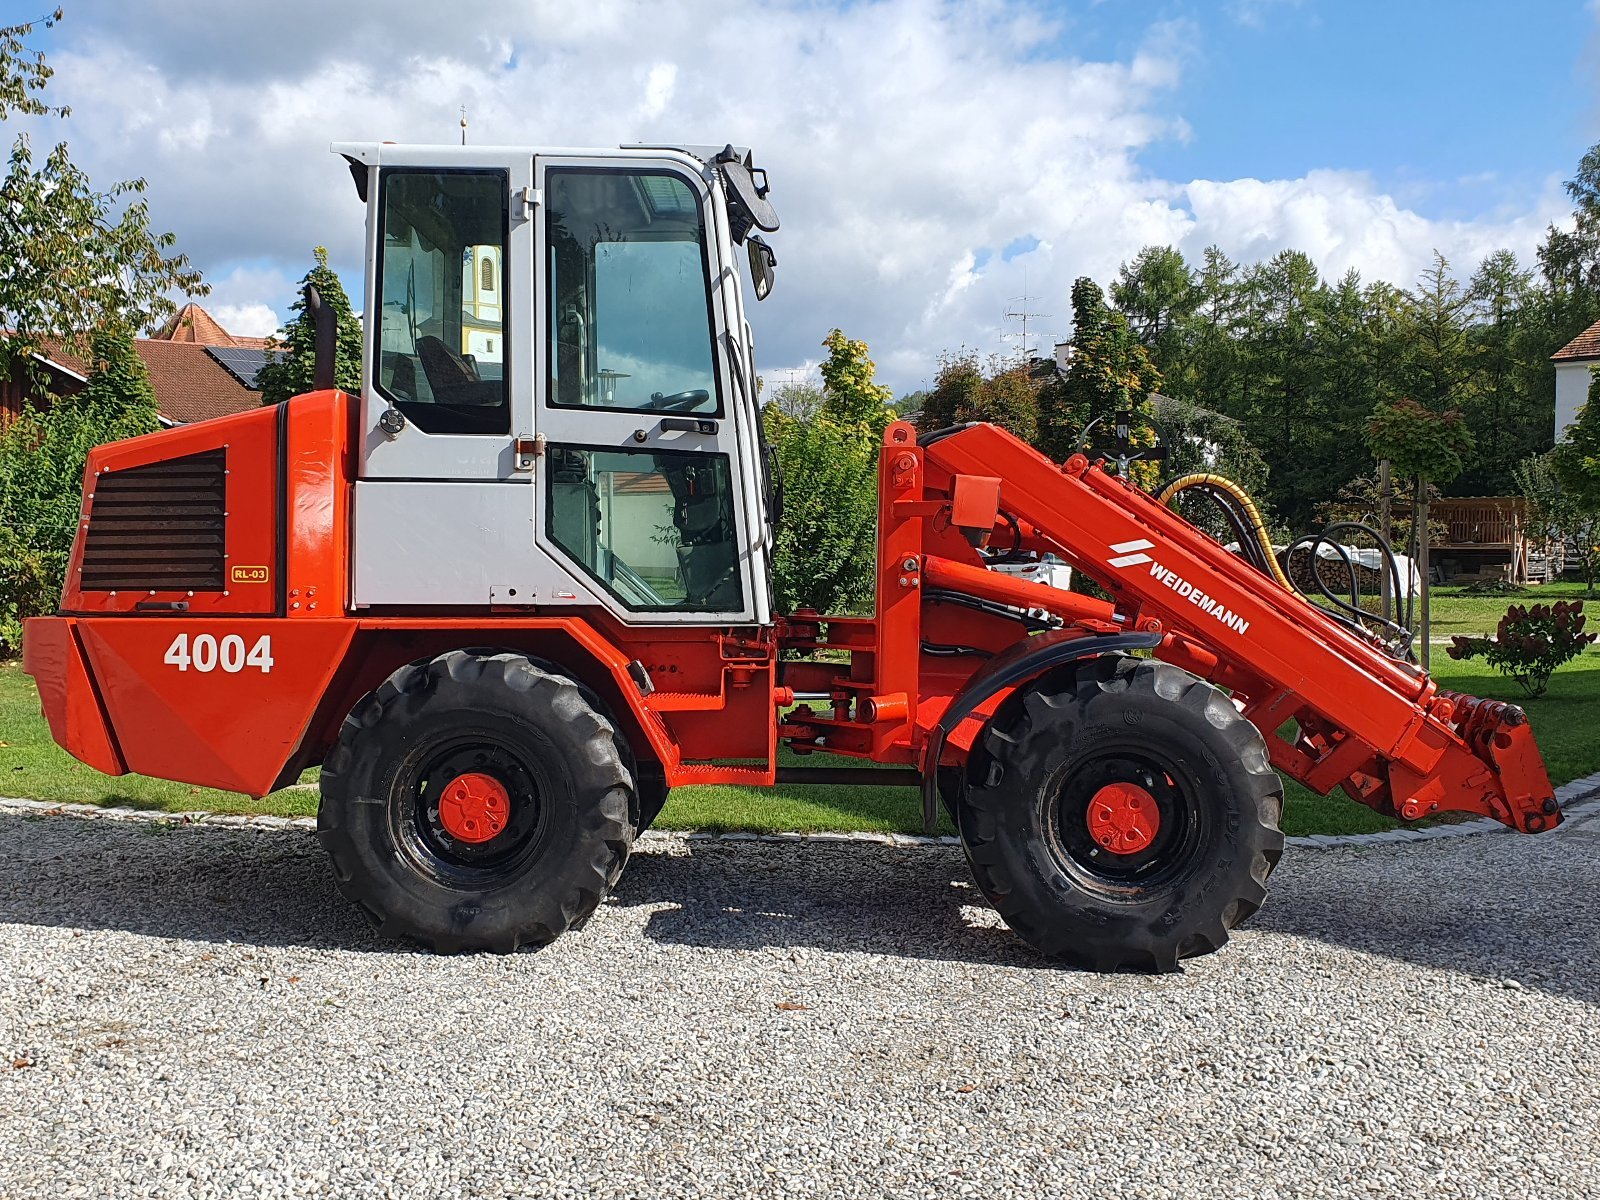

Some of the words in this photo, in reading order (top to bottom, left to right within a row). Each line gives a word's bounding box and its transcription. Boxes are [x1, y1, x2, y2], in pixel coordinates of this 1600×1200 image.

[234, 570, 265, 579] RL-03
[1149, 561, 1250, 635] WEIDEMANN
[164, 633, 274, 673] 4004
